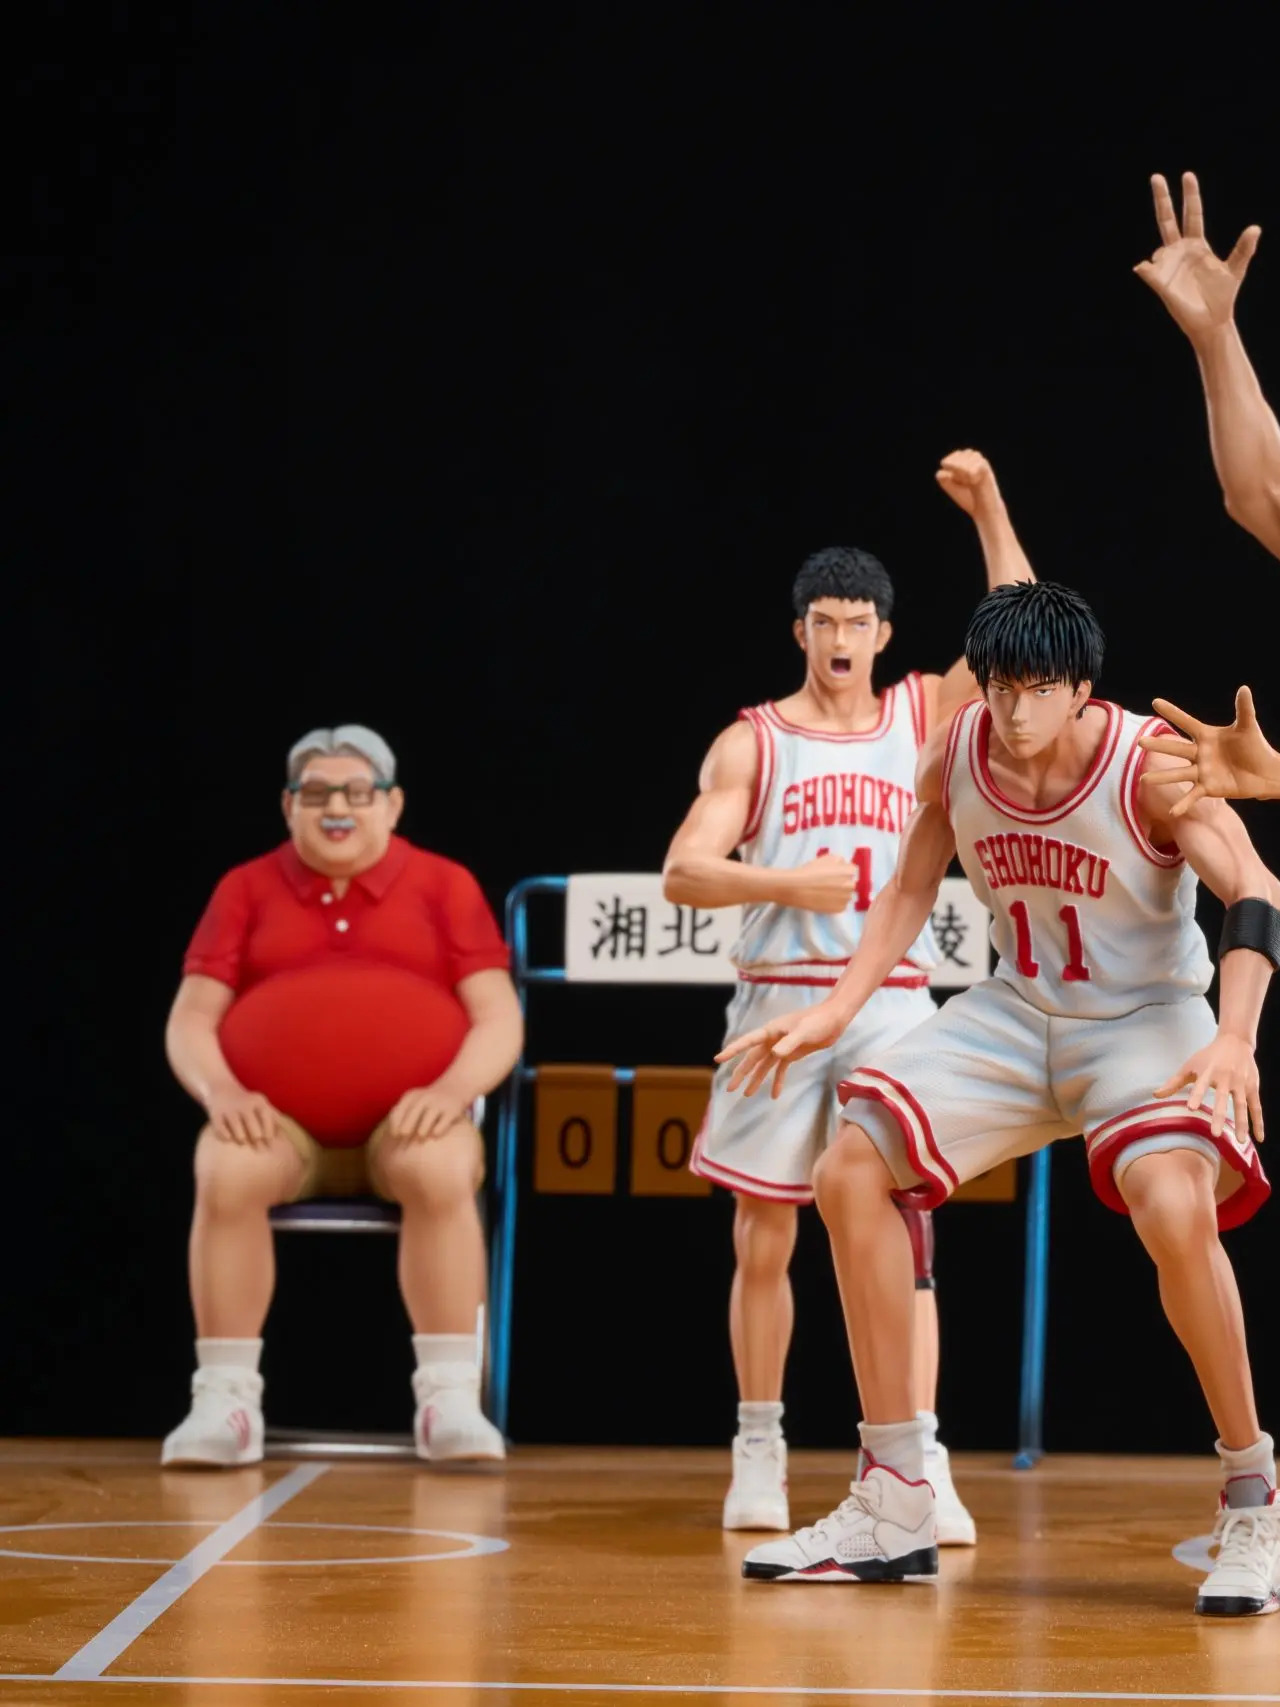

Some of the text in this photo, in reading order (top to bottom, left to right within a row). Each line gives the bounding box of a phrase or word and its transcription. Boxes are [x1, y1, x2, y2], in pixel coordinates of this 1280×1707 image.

[974, 832, 1110, 900] SHOHOKU
[590, 893, 721, 961] 湘北
[1009, 899, 1090, 982] 11
[559, 1116, 690, 1170] 0 0
